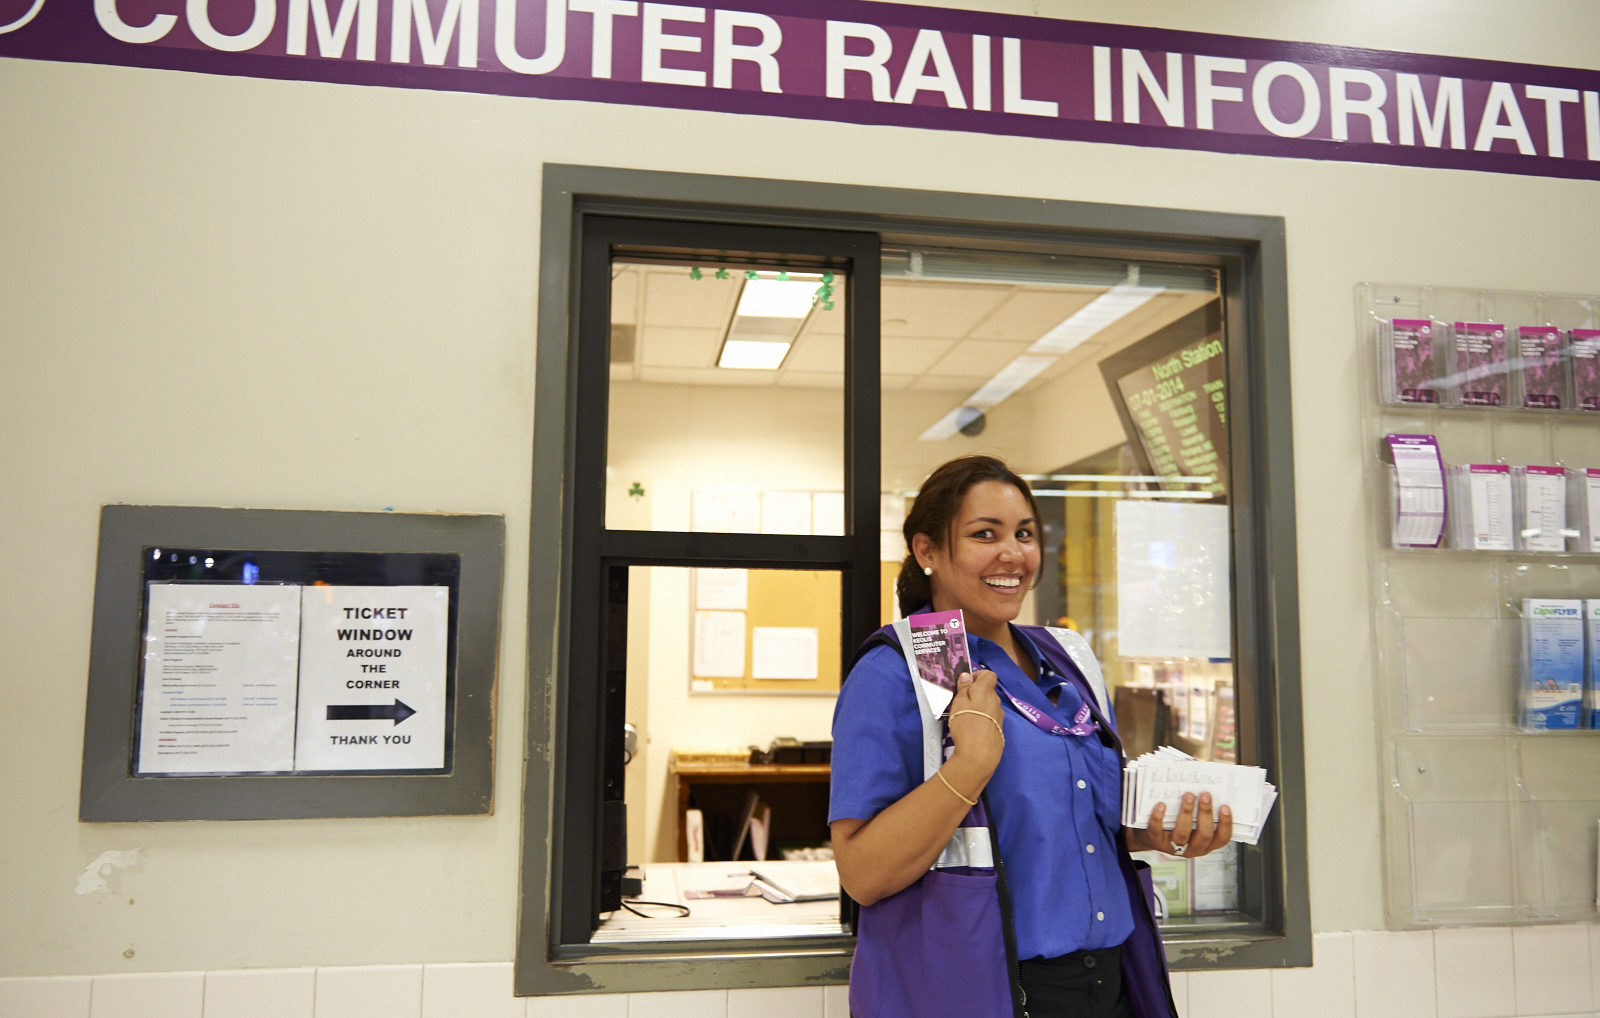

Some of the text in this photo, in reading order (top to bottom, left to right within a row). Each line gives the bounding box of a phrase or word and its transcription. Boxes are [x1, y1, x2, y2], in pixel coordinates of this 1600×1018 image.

[94, 0, 783, 94] COMMUTER
[825, 19, 1059, 118] RAIL
[1152, 339, 1224, 381] North Station
[343, 607, 408, 620] TICKET
[337, 628, 413, 641] WINDOW
[911, 629, 940, 638] WELCOME
[912, 636, 933, 644] KEOLIS
[913, 640, 947, 649] COMMUTER
[346, 648, 402, 658] AROUND
[914, 646, 942, 655] SERVICES
[360, 664, 387, 674] THE
[346, 680, 400, 689] CORNER
[330, 735, 411, 745] THANK YOU
